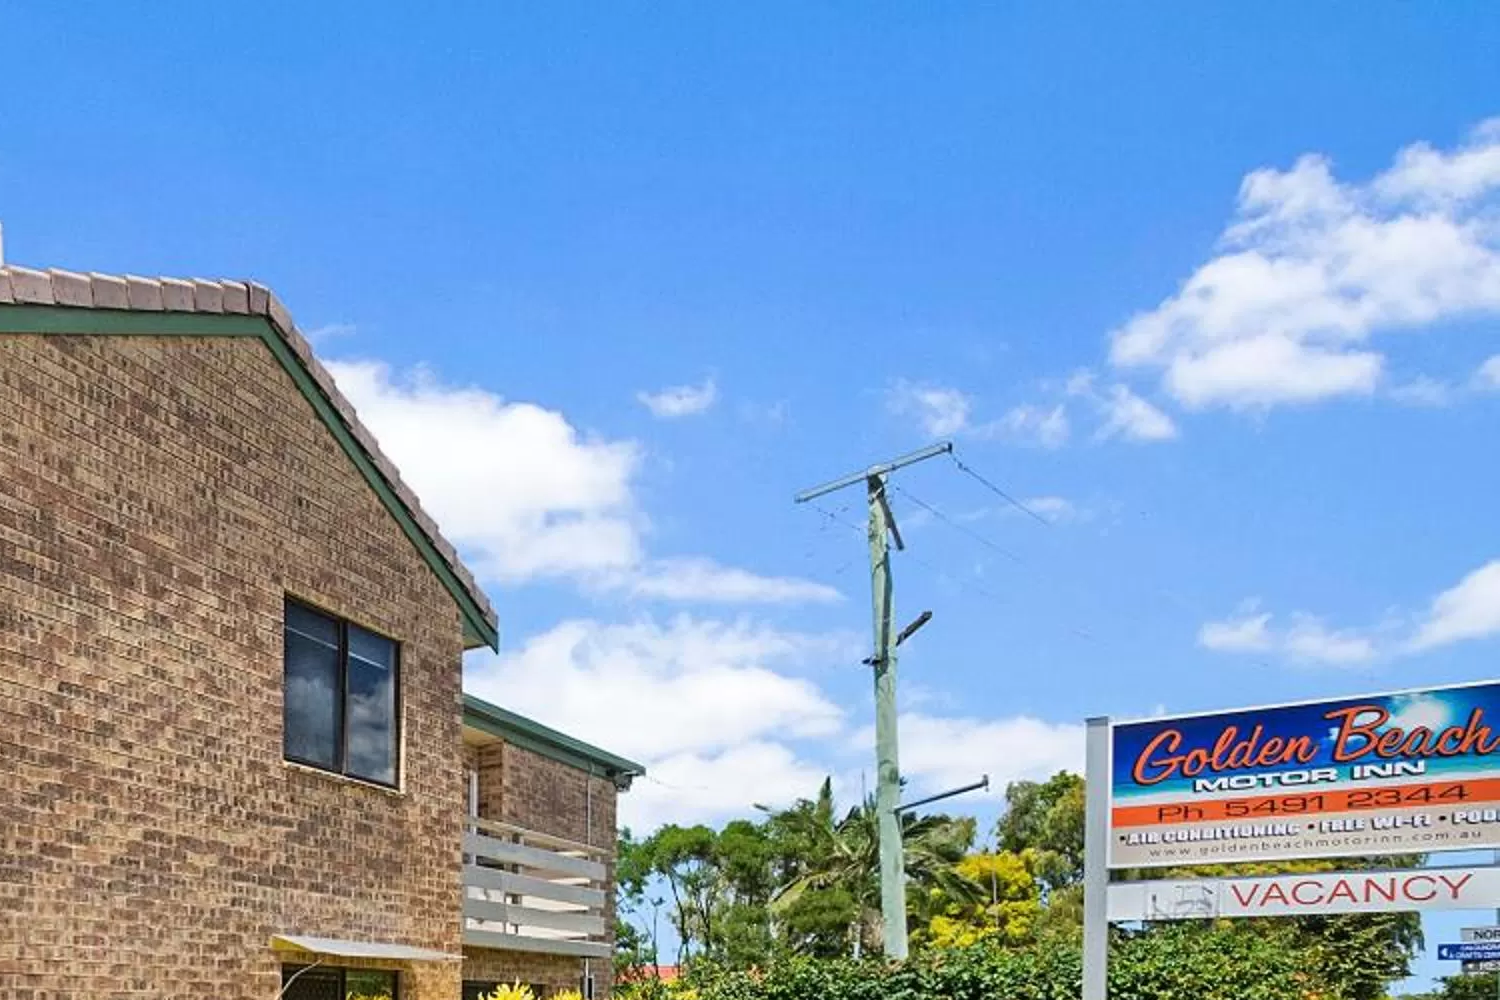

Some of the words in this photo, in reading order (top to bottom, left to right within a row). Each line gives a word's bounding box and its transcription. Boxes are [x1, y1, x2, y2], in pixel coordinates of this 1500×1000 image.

[1132, 723, 1318, 786] Golden
[1324, 704, 1500, 763] Beach
[1193, 767, 1338, 793] MOTOR
[1350, 759, 1425, 781] INN
[1158, 804, 1203, 823] Ph
[1225, 794, 1323, 817] 5491
[1347, 784, 1468, 808] 2344
[1126, 831, 1160, 846] AIR
[1162, 823, 1300, 844] CONDITIONING
[1320, 818, 1365, 834] FREE
[1371, 813, 1431, 830] WI-FI
[1452, 809, 1500, 825] POO
[1231, 873, 1474, 907] VACANCY
